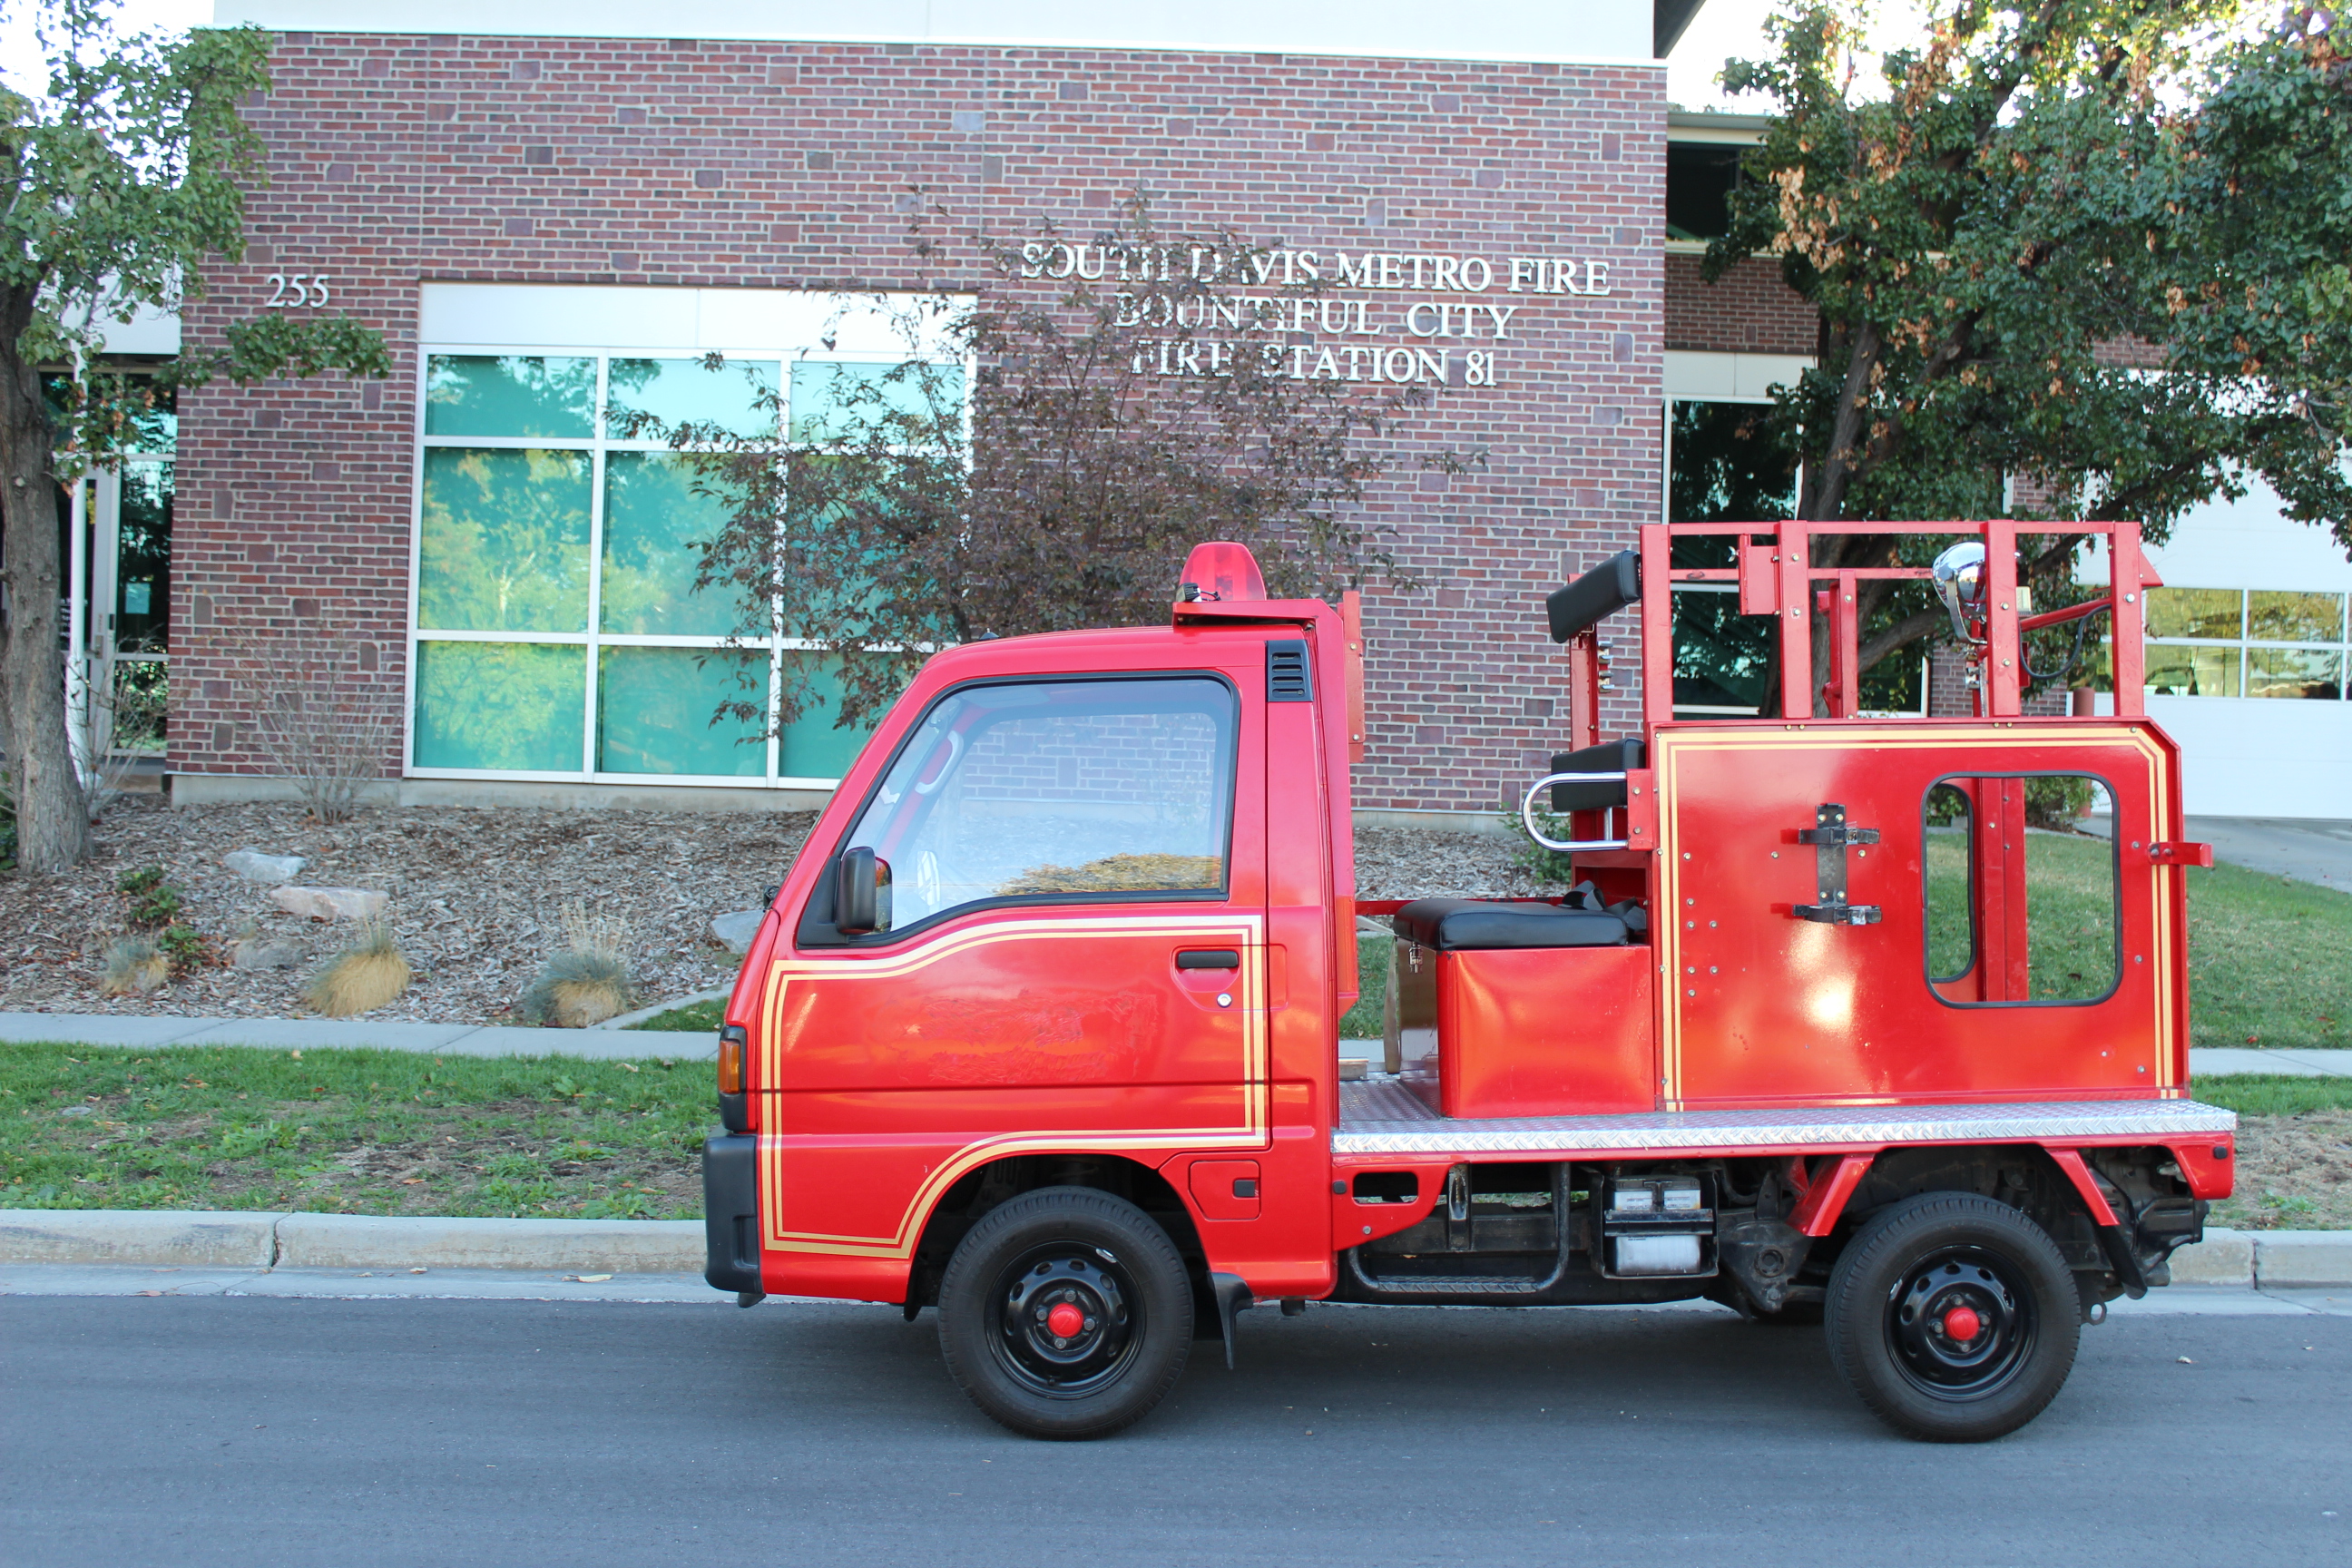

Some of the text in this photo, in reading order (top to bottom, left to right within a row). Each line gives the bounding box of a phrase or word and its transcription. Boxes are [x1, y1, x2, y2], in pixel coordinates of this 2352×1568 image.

[266, 273, 330, 308] 255
[1335, 252, 1493, 292] METRO
[1507, 257, 1612, 296] FIRE
[1112, 291, 1519, 339] BOUNTIFUL CITY
[1261, 343, 1450, 384] STATION
[1465, 349, 1497, 387] 81
